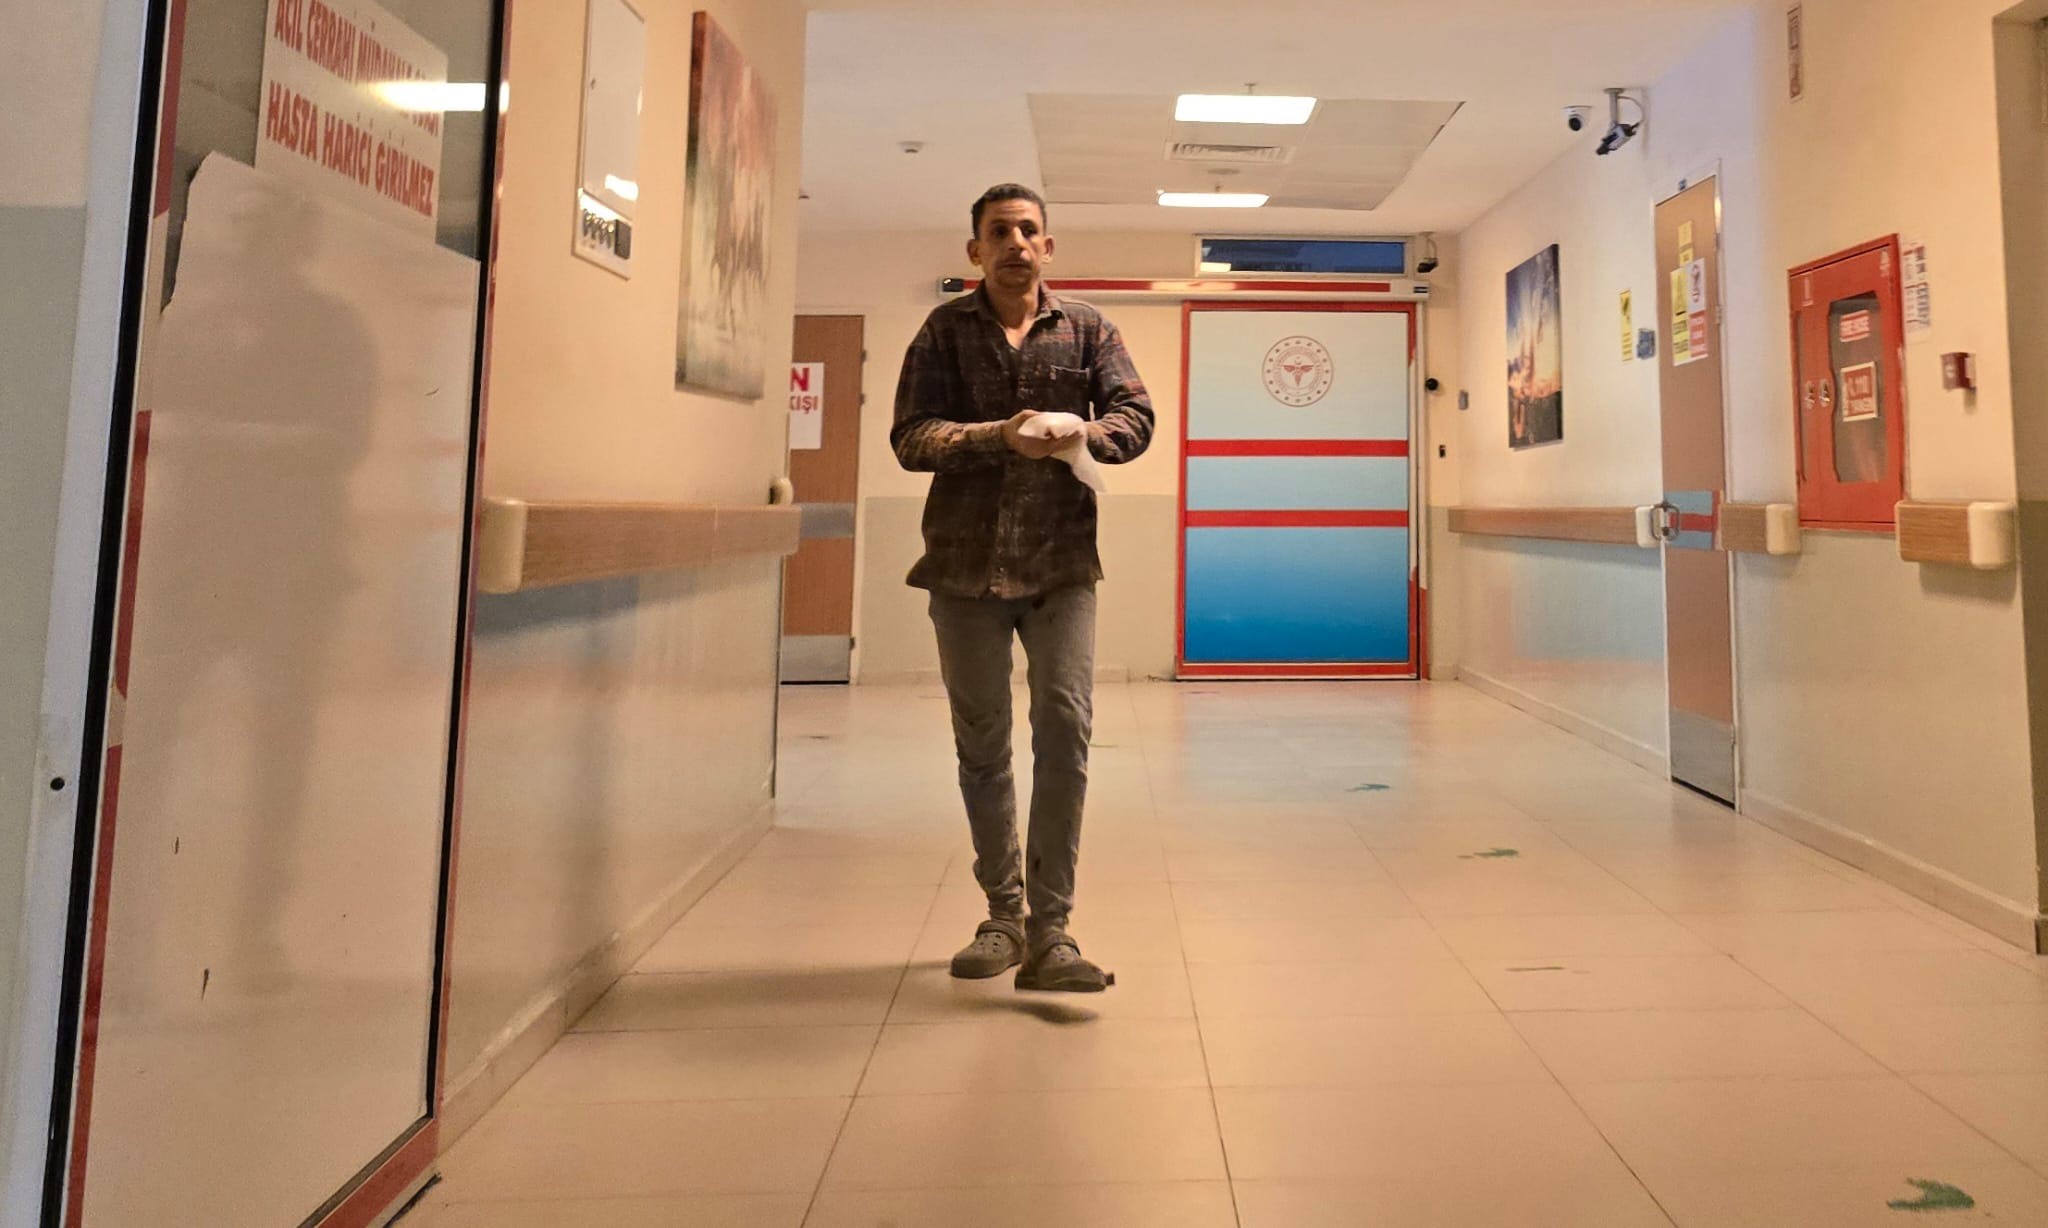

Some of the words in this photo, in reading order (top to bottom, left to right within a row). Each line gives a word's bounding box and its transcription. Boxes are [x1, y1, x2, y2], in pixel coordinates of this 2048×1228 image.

[266, 80, 319, 162] HASTA
[323, 112, 374, 187] HARİCİ
[375, 131, 435, 217] GİRİLMEZ
